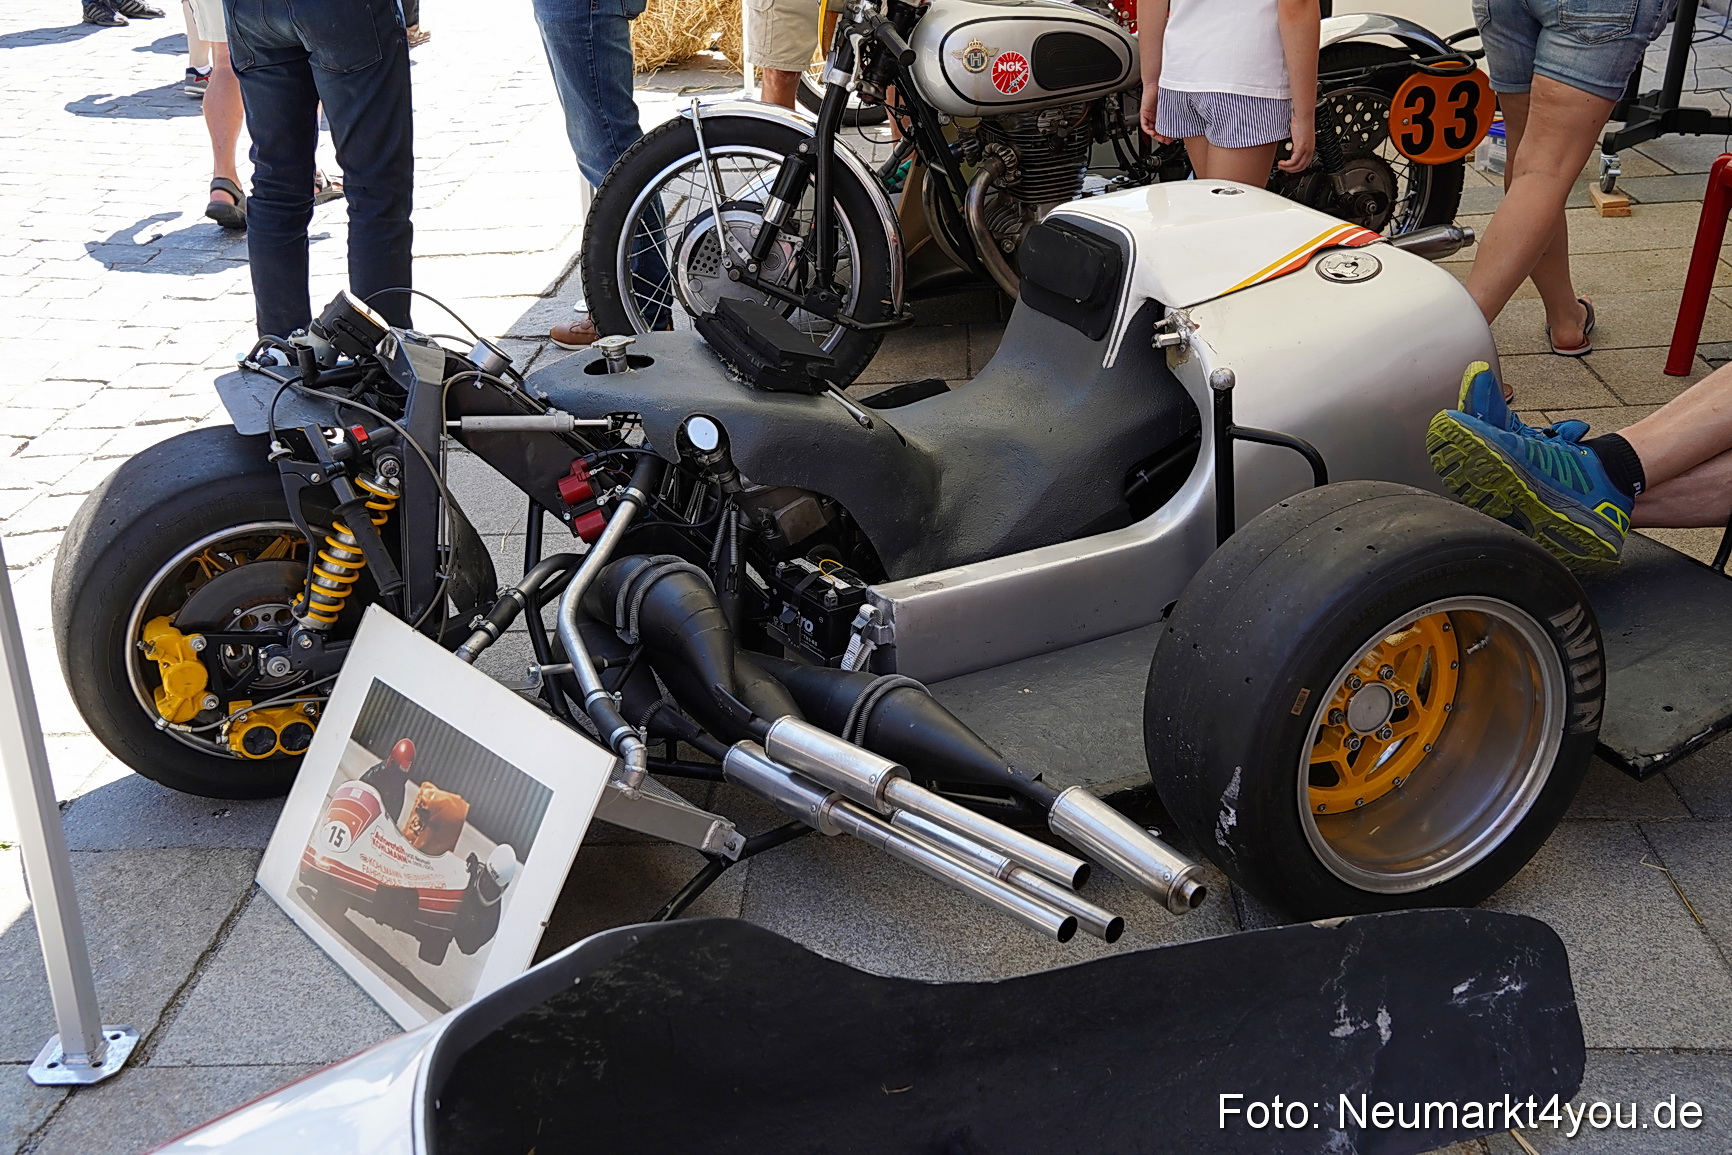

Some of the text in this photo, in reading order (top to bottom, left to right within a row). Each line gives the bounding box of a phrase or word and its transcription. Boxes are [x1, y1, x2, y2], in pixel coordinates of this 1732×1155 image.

[997, 61, 1024, 73] NGK
[1401, 80, 1480, 155] 33
[1548, 601, 1602, 735] AVON
[328, 825, 346, 848] 15
